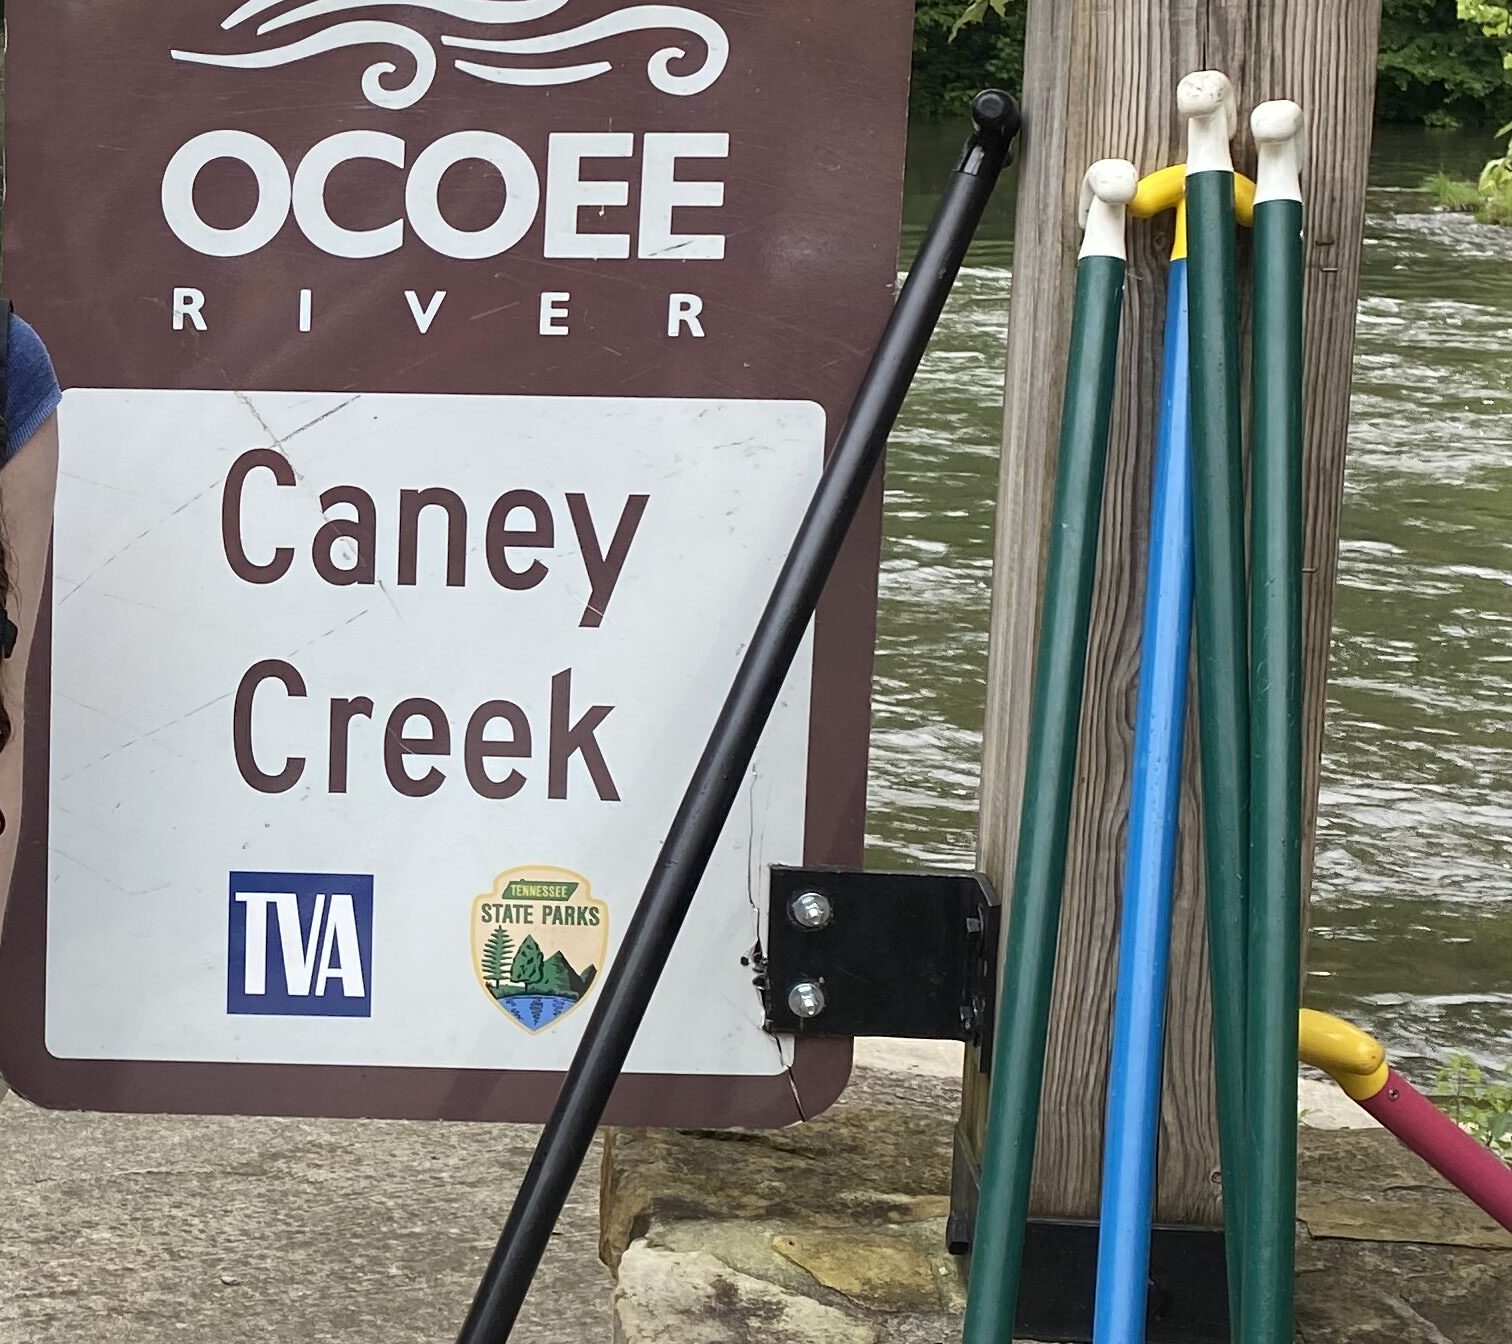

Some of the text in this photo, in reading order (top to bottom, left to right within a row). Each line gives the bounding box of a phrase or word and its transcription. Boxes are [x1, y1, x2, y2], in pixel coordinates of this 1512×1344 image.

[161, 130, 729, 260] OCOEE
[172, 287, 705, 337] RIVER
[221, 448, 649, 629] Caney
[232, 659, 621, 802] Creek
[481, 904, 600, 926] STATE PARKS
[510, 885, 567, 898] TENNESSEE
[235, 892, 366, 998] TVA
